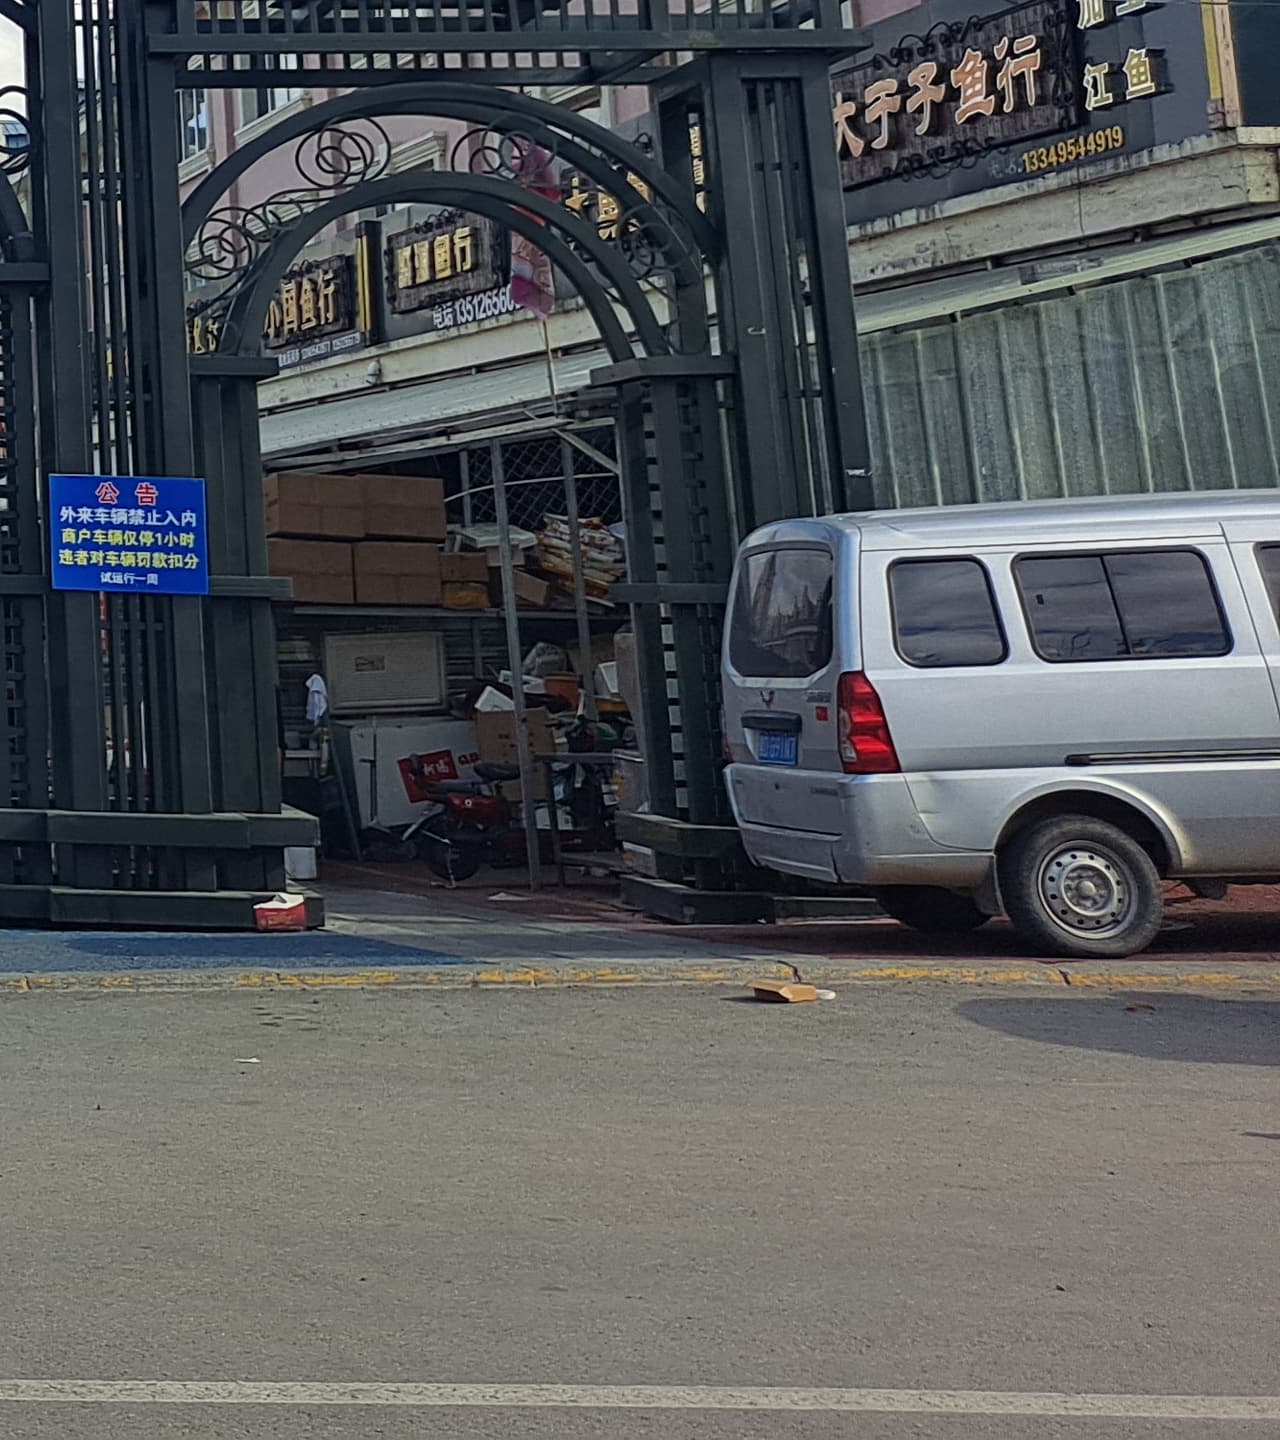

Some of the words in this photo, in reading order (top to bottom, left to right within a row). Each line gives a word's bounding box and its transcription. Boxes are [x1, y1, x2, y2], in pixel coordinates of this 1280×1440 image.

[1083, 48, 1156, 111] 江鱼
[1021, 125, 1124, 174] 13349544919
[433, 302, 453, 328] 电话
[95, 481, 158, 506] 公告
[59, 506, 197, 527] 外来车辆禁止入内
[60, 527, 196, 548] 商户车辆仅停1小时
